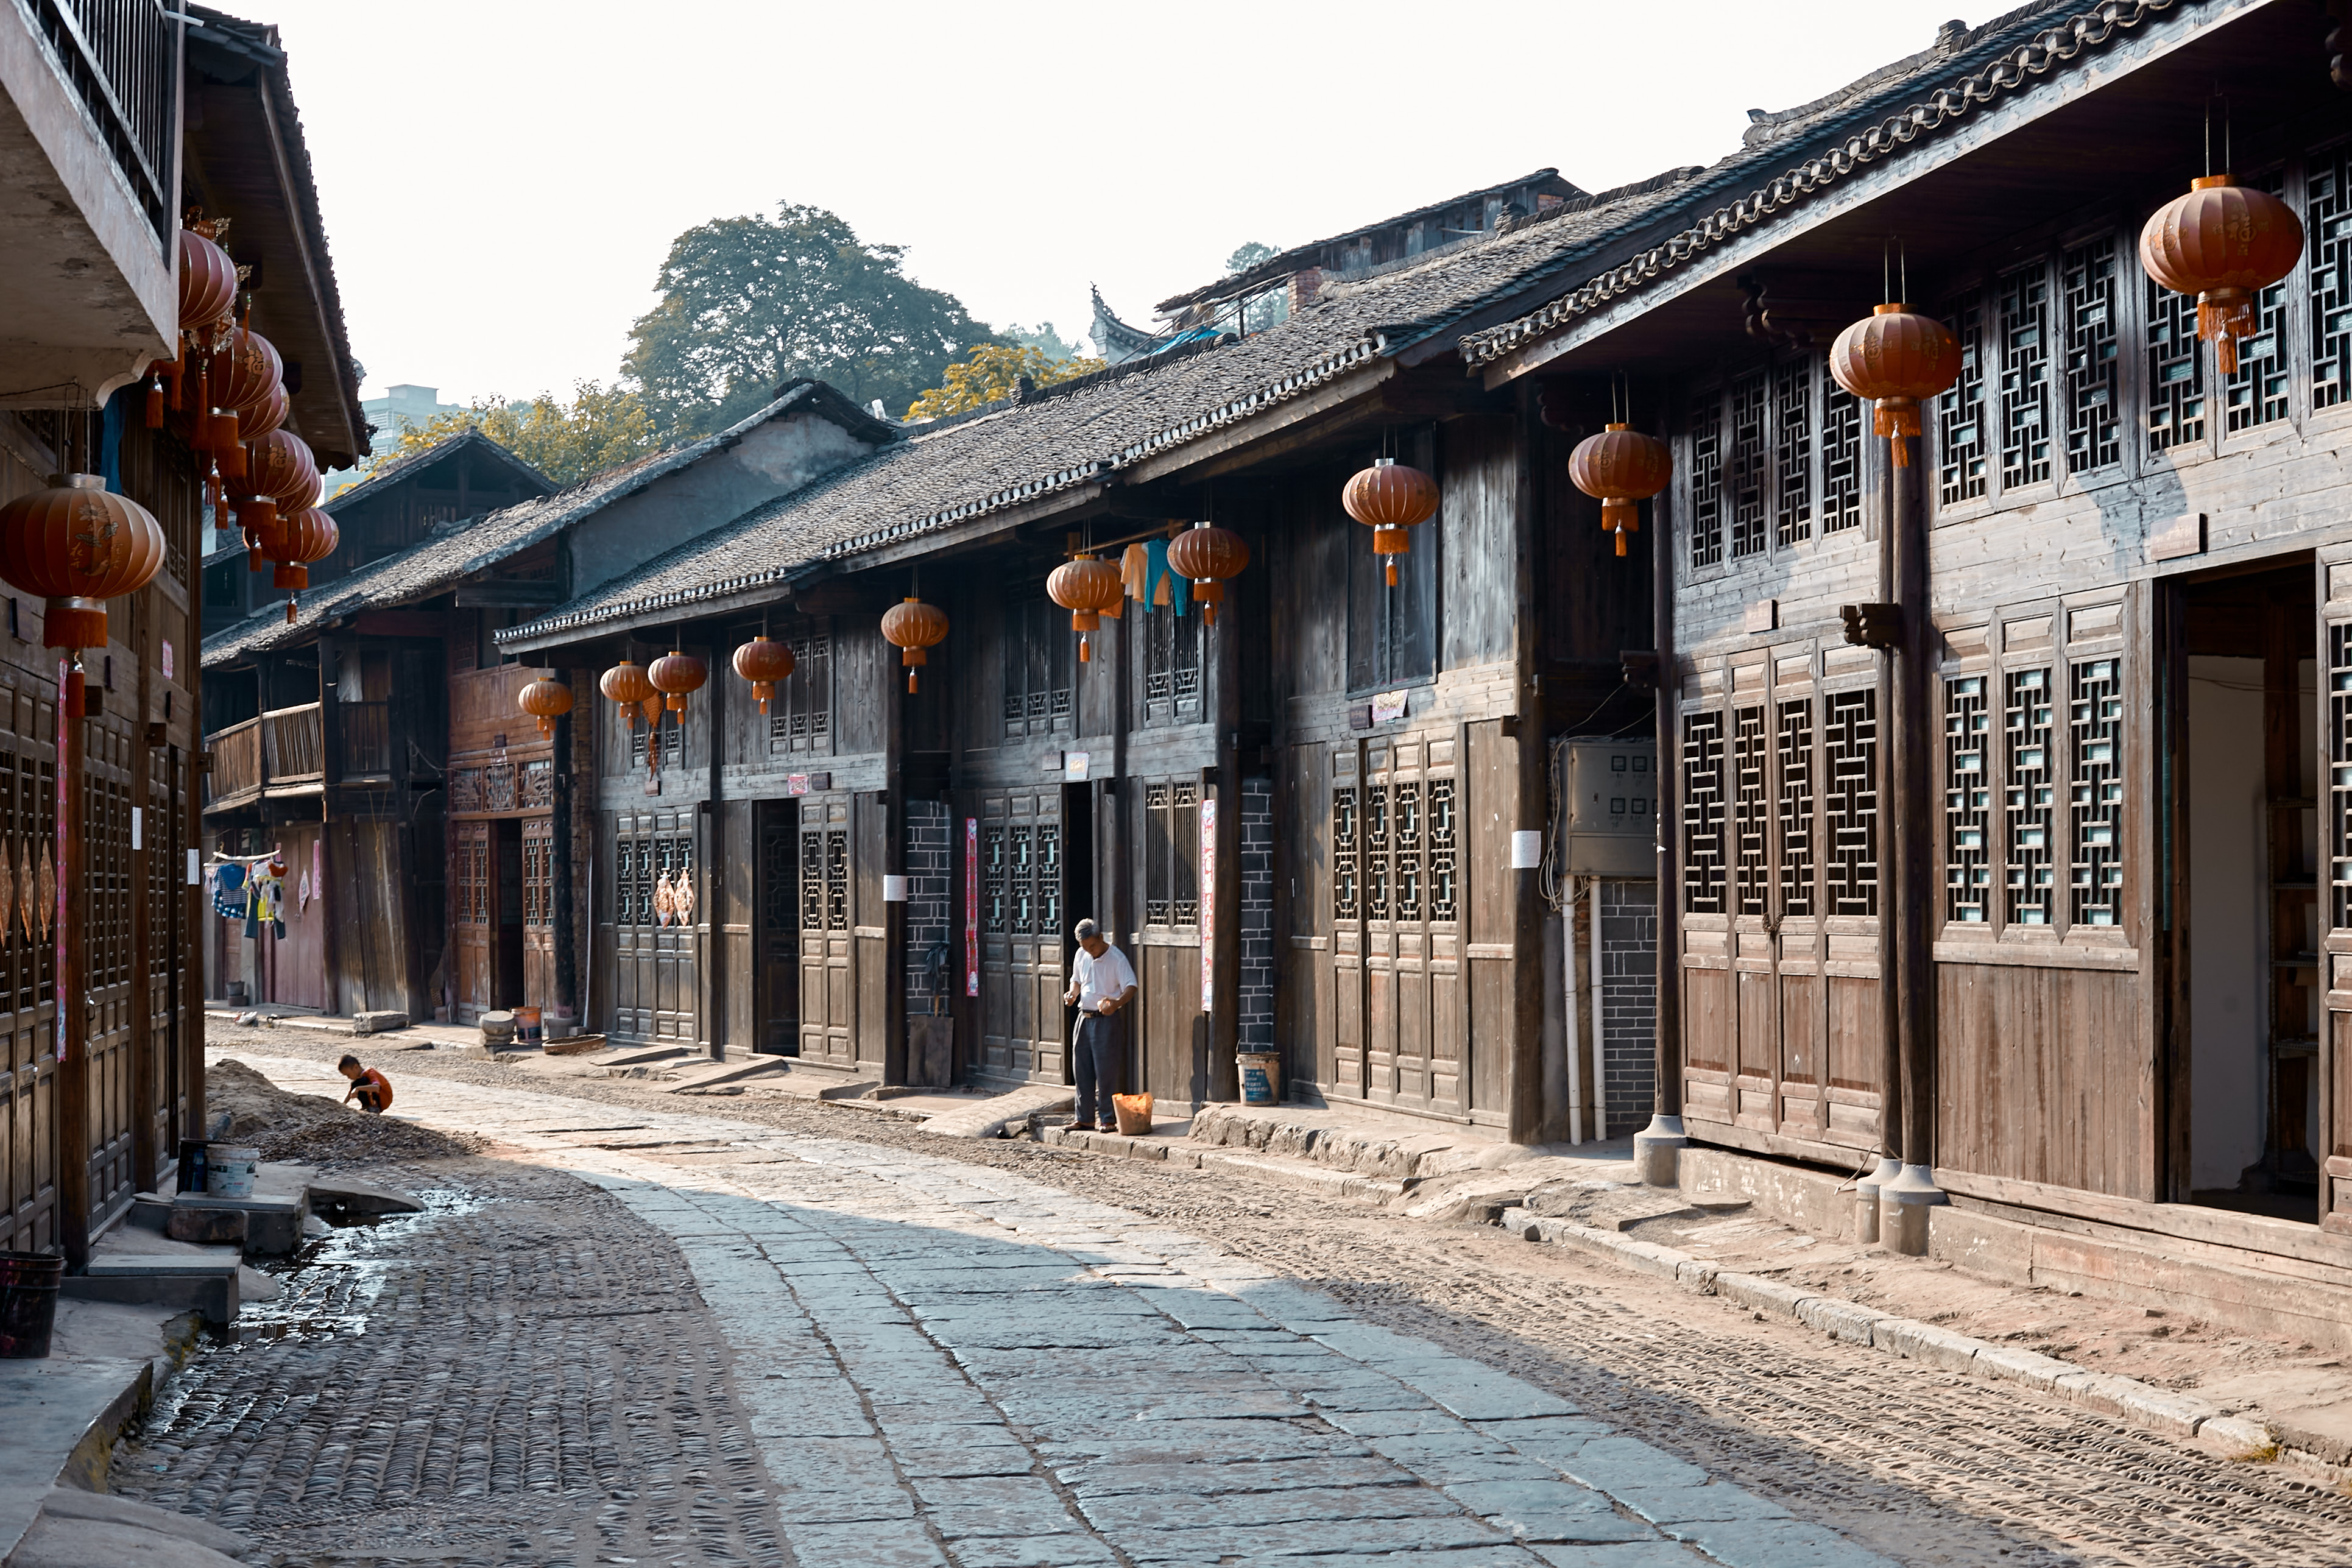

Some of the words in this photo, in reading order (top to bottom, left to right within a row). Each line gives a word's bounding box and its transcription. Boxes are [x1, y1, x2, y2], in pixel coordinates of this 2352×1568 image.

[2226, 213, 2258, 242] 福
[1857, 335, 1882, 358] 福
[244, 350, 266, 375] 福
[267, 447, 288, 468] 福
